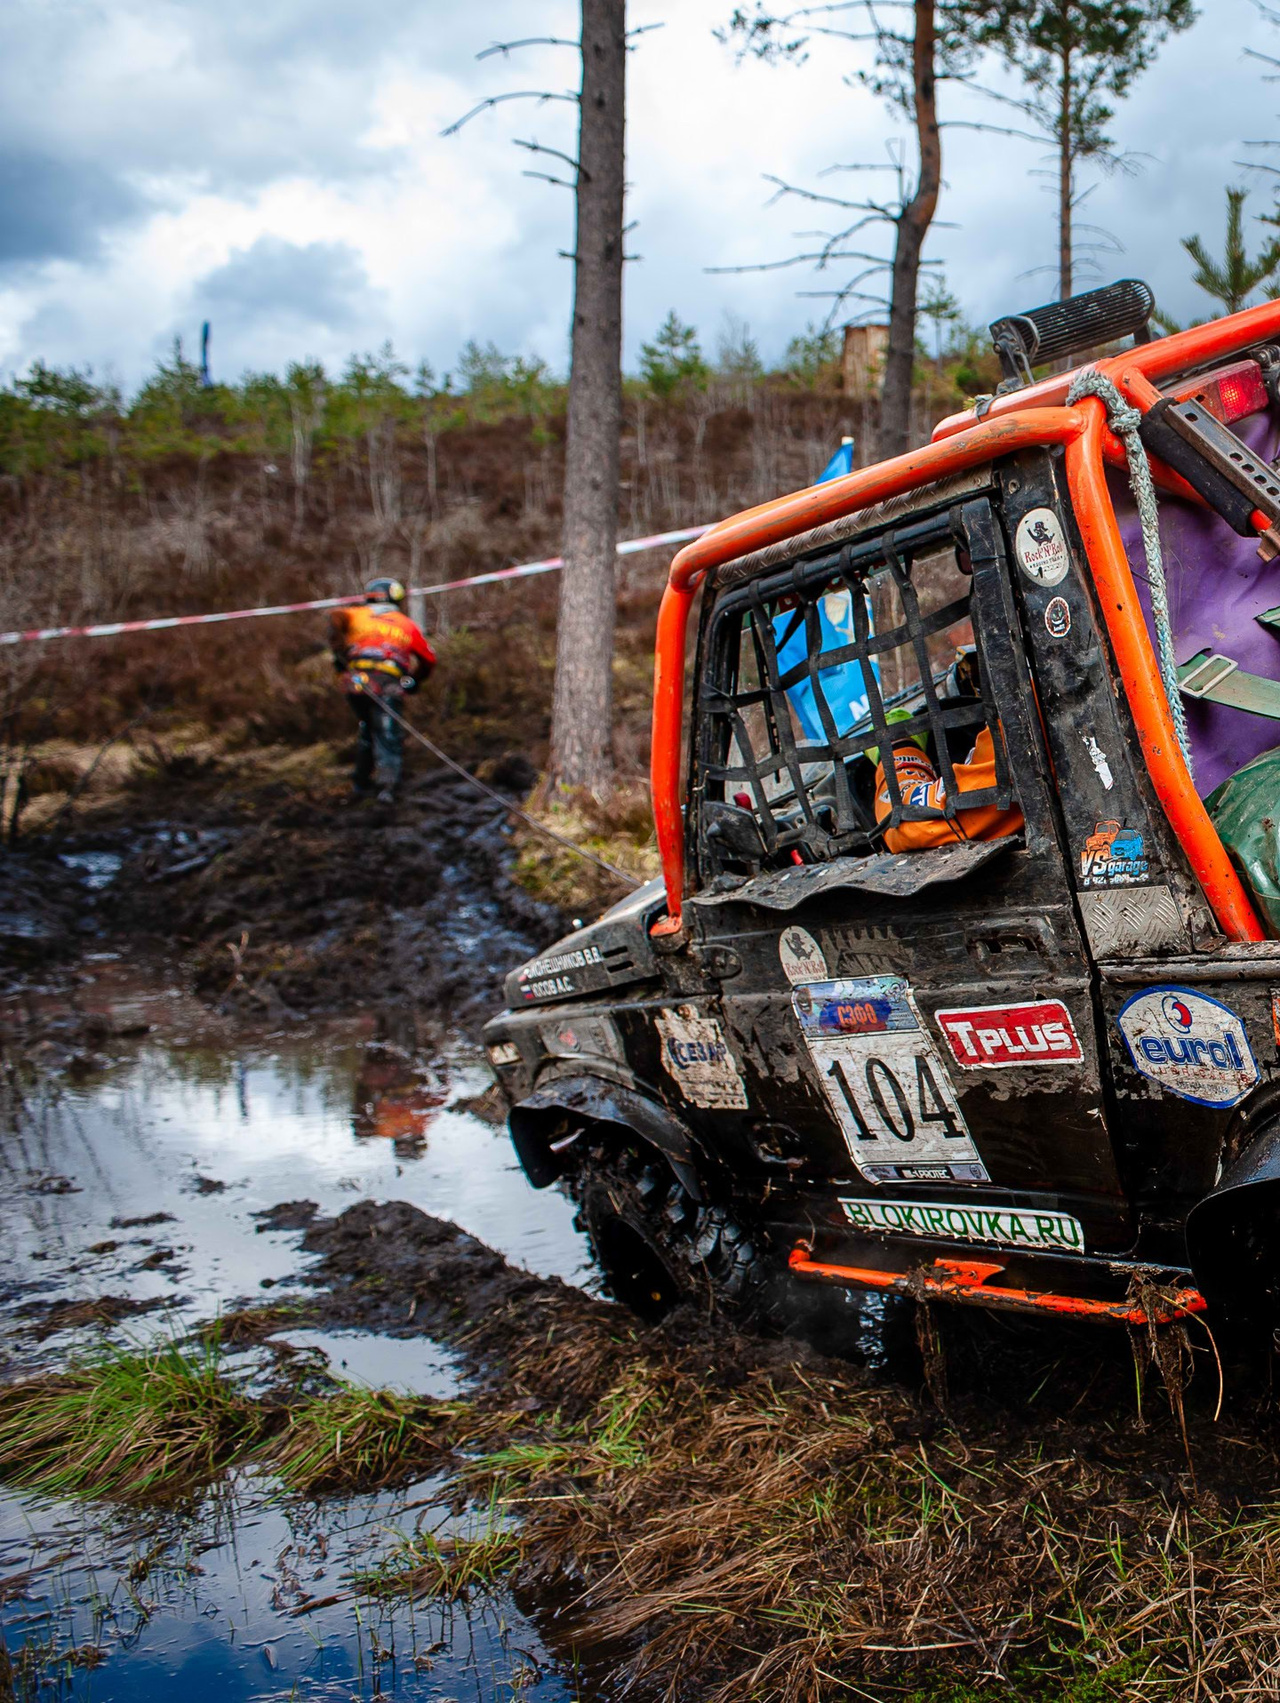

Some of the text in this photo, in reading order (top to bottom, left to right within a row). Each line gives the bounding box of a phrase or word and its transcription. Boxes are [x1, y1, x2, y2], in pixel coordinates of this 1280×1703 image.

[837, 1002, 878, 1026] СЗФО
[945, 1021, 1073, 1057] TPLUS
[1139, 1031, 1245, 1070] eurol
[826, 1055, 966, 1143] 104
[850, 1203, 1081, 1248] BLOKIROVKA.RU
